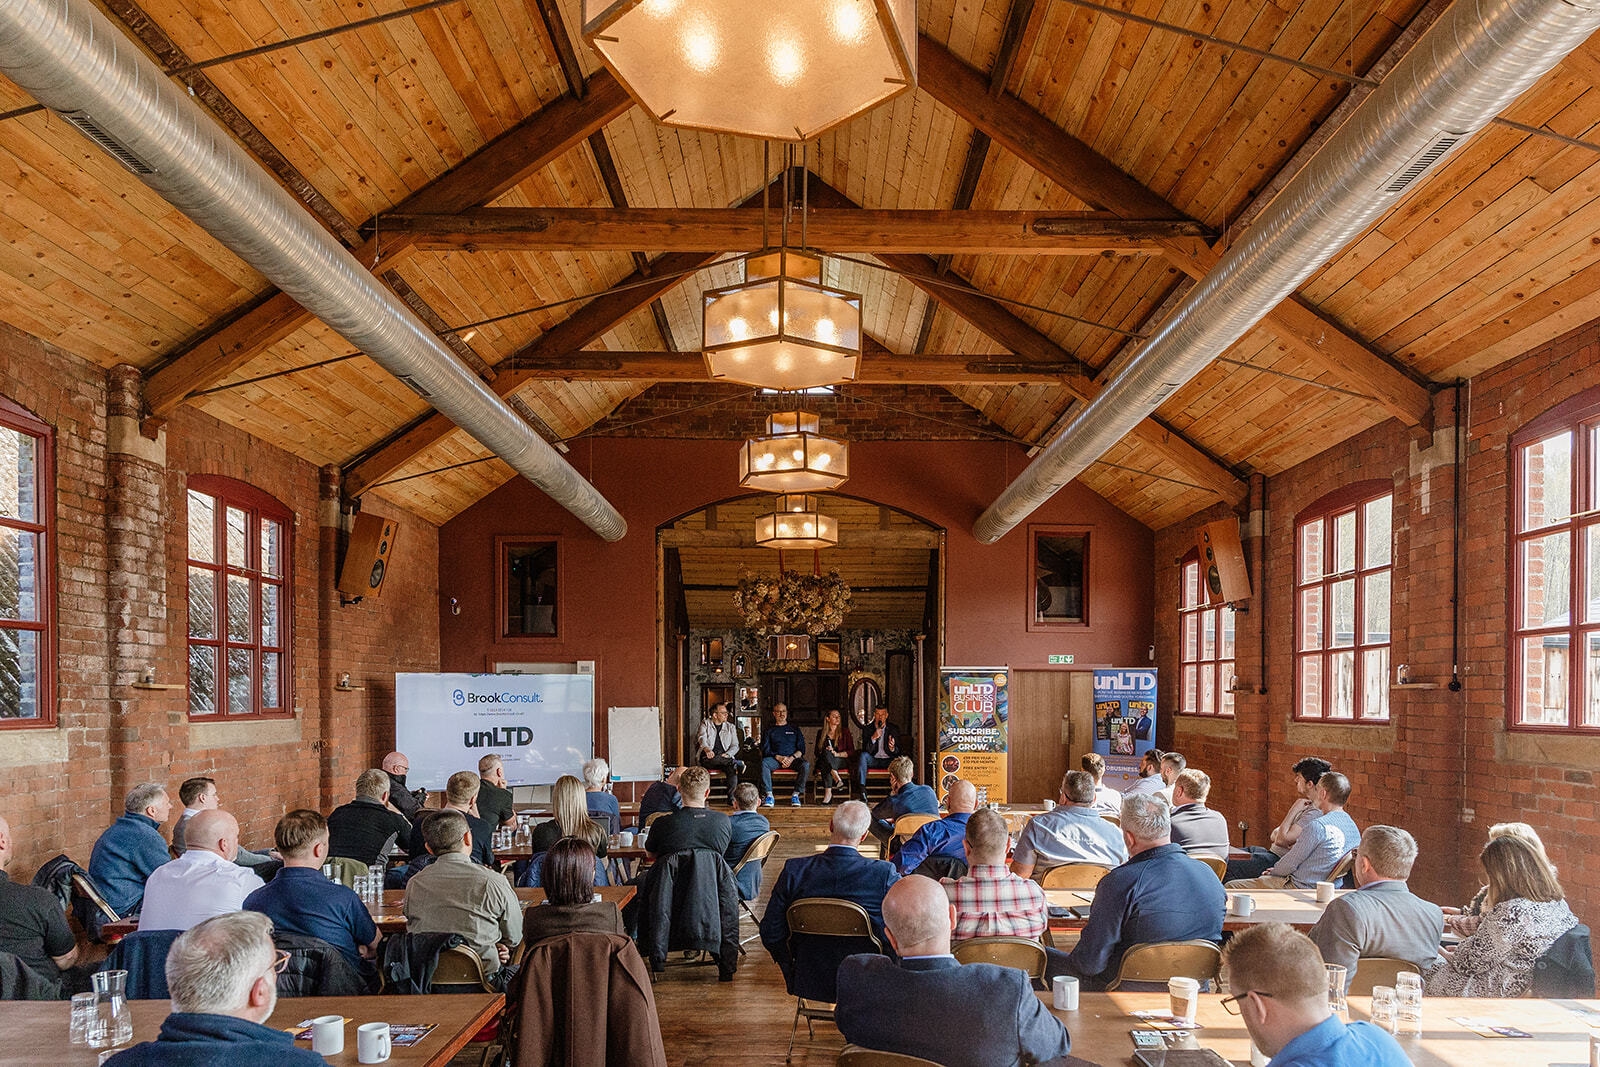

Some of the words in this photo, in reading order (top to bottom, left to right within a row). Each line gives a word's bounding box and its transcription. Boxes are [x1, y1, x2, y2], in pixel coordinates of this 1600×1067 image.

[1094, 672, 1156, 690] unLTD
[954, 683, 994, 695] unLTD
[954, 694, 994, 702] BUSINESS
[954, 701, 994, 713] CLUB
[464, 726, 534, 747] unLTD
